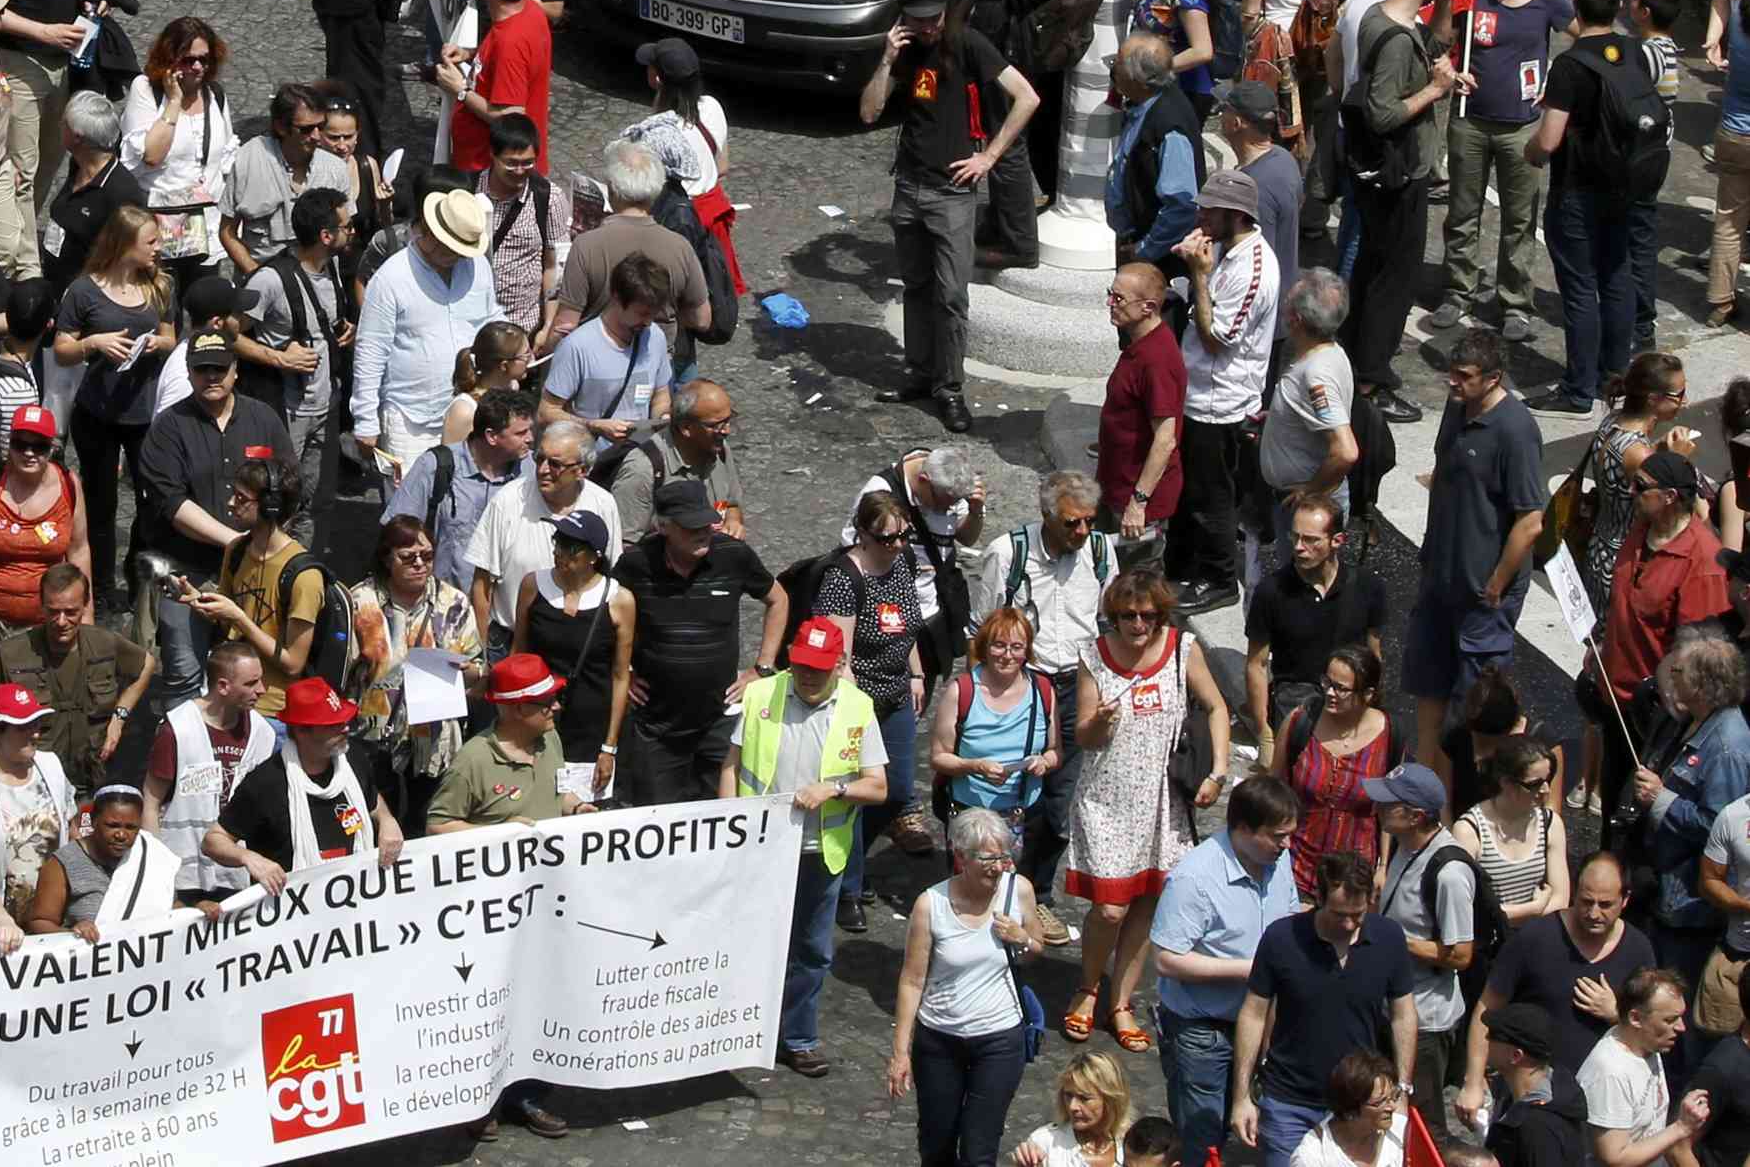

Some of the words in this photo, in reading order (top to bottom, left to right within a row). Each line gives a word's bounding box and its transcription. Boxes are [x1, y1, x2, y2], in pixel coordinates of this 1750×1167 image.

[1133, 691, 1161, 708] cgt
[0, 929, 174, 991] VALENT
[184, 881, 310, 956] MIEUX
[325, 856, 417, 911] QUE
[432, 834, 566, 887] LEURS
[580, 812, 749, 867] PROFITS
[757, 809, 770, 844] !
[105, 979, 172, 1025] LOI
[214, 920, 390, 993] TRAVAIL
[436, 883, 544, 941] C'EST
[595, 962, 650, 988] Lutter
[652, 957, 709, 982] contre
[712, 949, 730, 970] la
[395, 991, 470, 1023] Investir
[600, 990, 660, 1016] fraude
[664, 979, 720, 1006] fiscale
[318, 1007, 346, 1037] 77
[541, 1017, 572, 1041] Un
[576, 1017, 654, 1045] contrôle
[659, 1011, 690, 1036] des
[693, 1006, 738, 1032] aides
[741, 1003, 762, 1024] et
[268, 1034, 360, 1080] la
[394, 1061, 414, 1085] la
[531, 1043, 660, 1073] exonérations
[663, 1044, 685, 1067] au
[686, 1031, 764, 1069] patronat
[29, 1080, 55, 1104] Du
[56, 1069, 122, 1099] travail
[126, 1061, 171, 1091] pour
[175, 1048, 215, 1076] tous
[266, 1052, 366, 1129] cgt
[1, 1117, 50, 1149] grâce
[54, 1107, 67, 1131] à
[70, 1105, 88, 1127] la
[92, 1085, 173, 1119] semaine
[175, 1079, 200, 1104] de
[203, 1073, 228, 1098] 32
[231, 1066, 248, 1089] H
[381, 1095, 402, 1118] le
[41, 1143, 62, 1166] La
[65, 1125, 136, 1162] retraite
[140, 1121, 152, 1144] à
[155, 1117, 182, 1140] 60
[185, 1111, 220, 1136] ans
